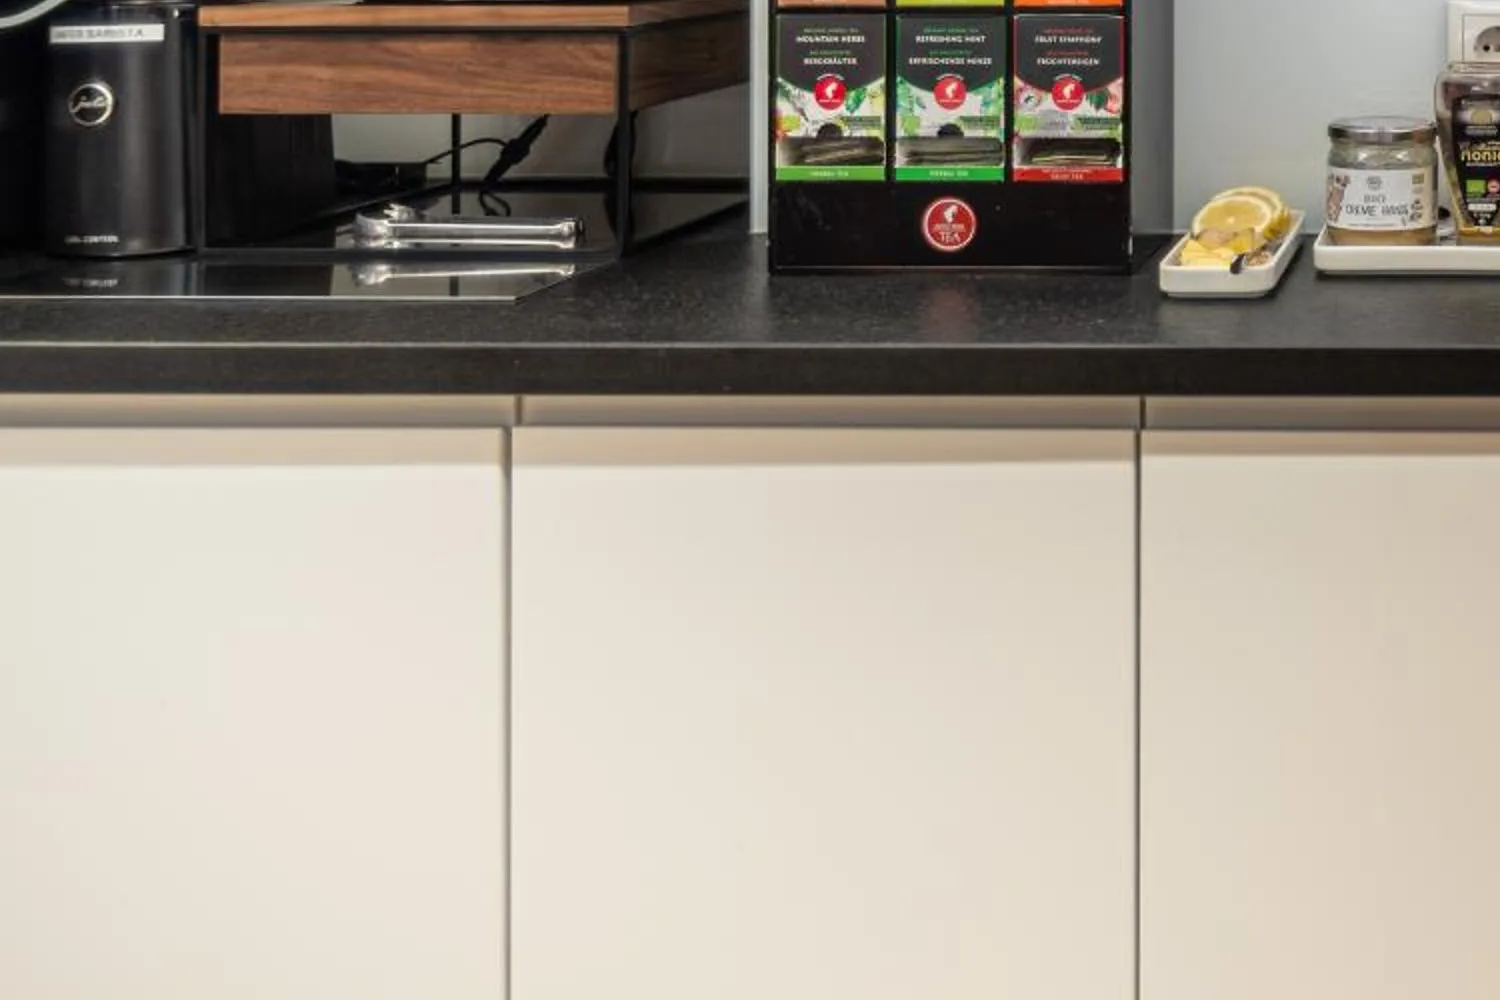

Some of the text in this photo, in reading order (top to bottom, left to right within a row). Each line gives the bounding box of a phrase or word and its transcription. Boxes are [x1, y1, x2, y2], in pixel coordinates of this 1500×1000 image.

[796, 35, 866, 43] MOUNTAIN HERBS
[915, 35, 986, 43] REFRESHING MINT
[1034, 35, 1103, 43] FRUIT SYMPHONY
